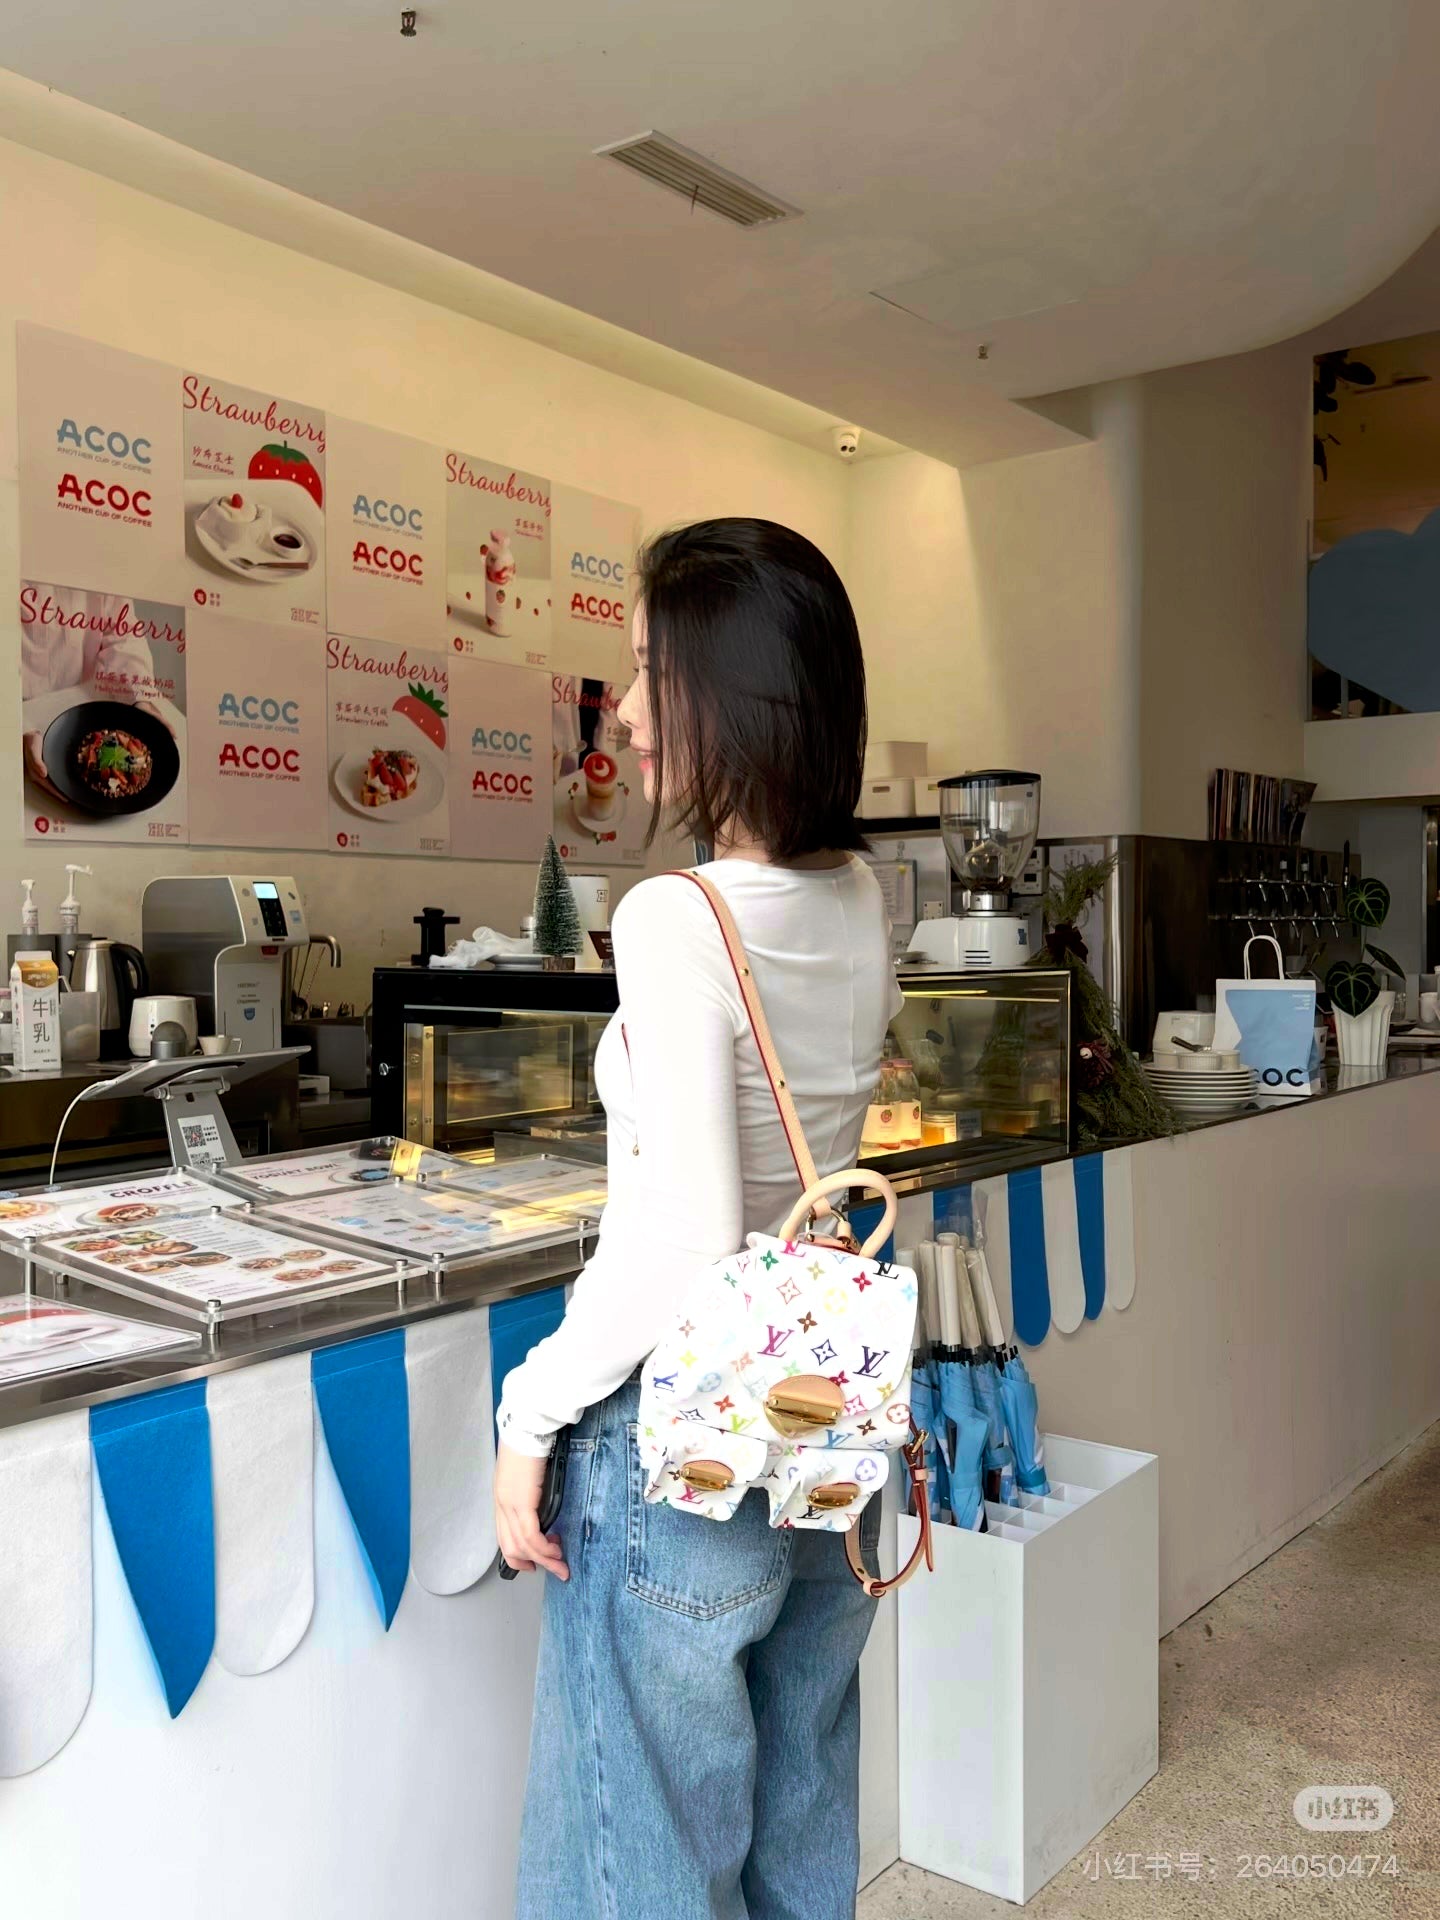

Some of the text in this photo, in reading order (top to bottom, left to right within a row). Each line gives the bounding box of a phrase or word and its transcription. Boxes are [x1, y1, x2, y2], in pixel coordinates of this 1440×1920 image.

[183, 376, 326, 453] Strawberry
[57, 419, 151, 464] ACOC
[58, 474, 152, 516] ACOC
[446, 453, 551, 517] Strawberry
[57, 501, 93, 514] ANOTHER
[94, 509, 110, 518] CUP
[123, 516, 152, 527] COFFEE
[353, 495, 423, 531] ACOC
[353, 541, 423, 576] ACOC
[571, 552, 624, 582] ACOC
[20, 587, 186, 653] Strawberry
[571, 593, 624, 621] ACOC
[326, 638, 448, 693] Strawberry
[219, 693, 299, 725] ACOC
[472, 728, 532, 753] ACOC
[219, 743, 300, 773] ACOC
[472, 770, 533, 796] ACOC
[32, 997, 50, 1043] 牛乳
[1254, 1068, 1304, 1087] OC
[110, 1181, 195, 1198] CROFFLE
